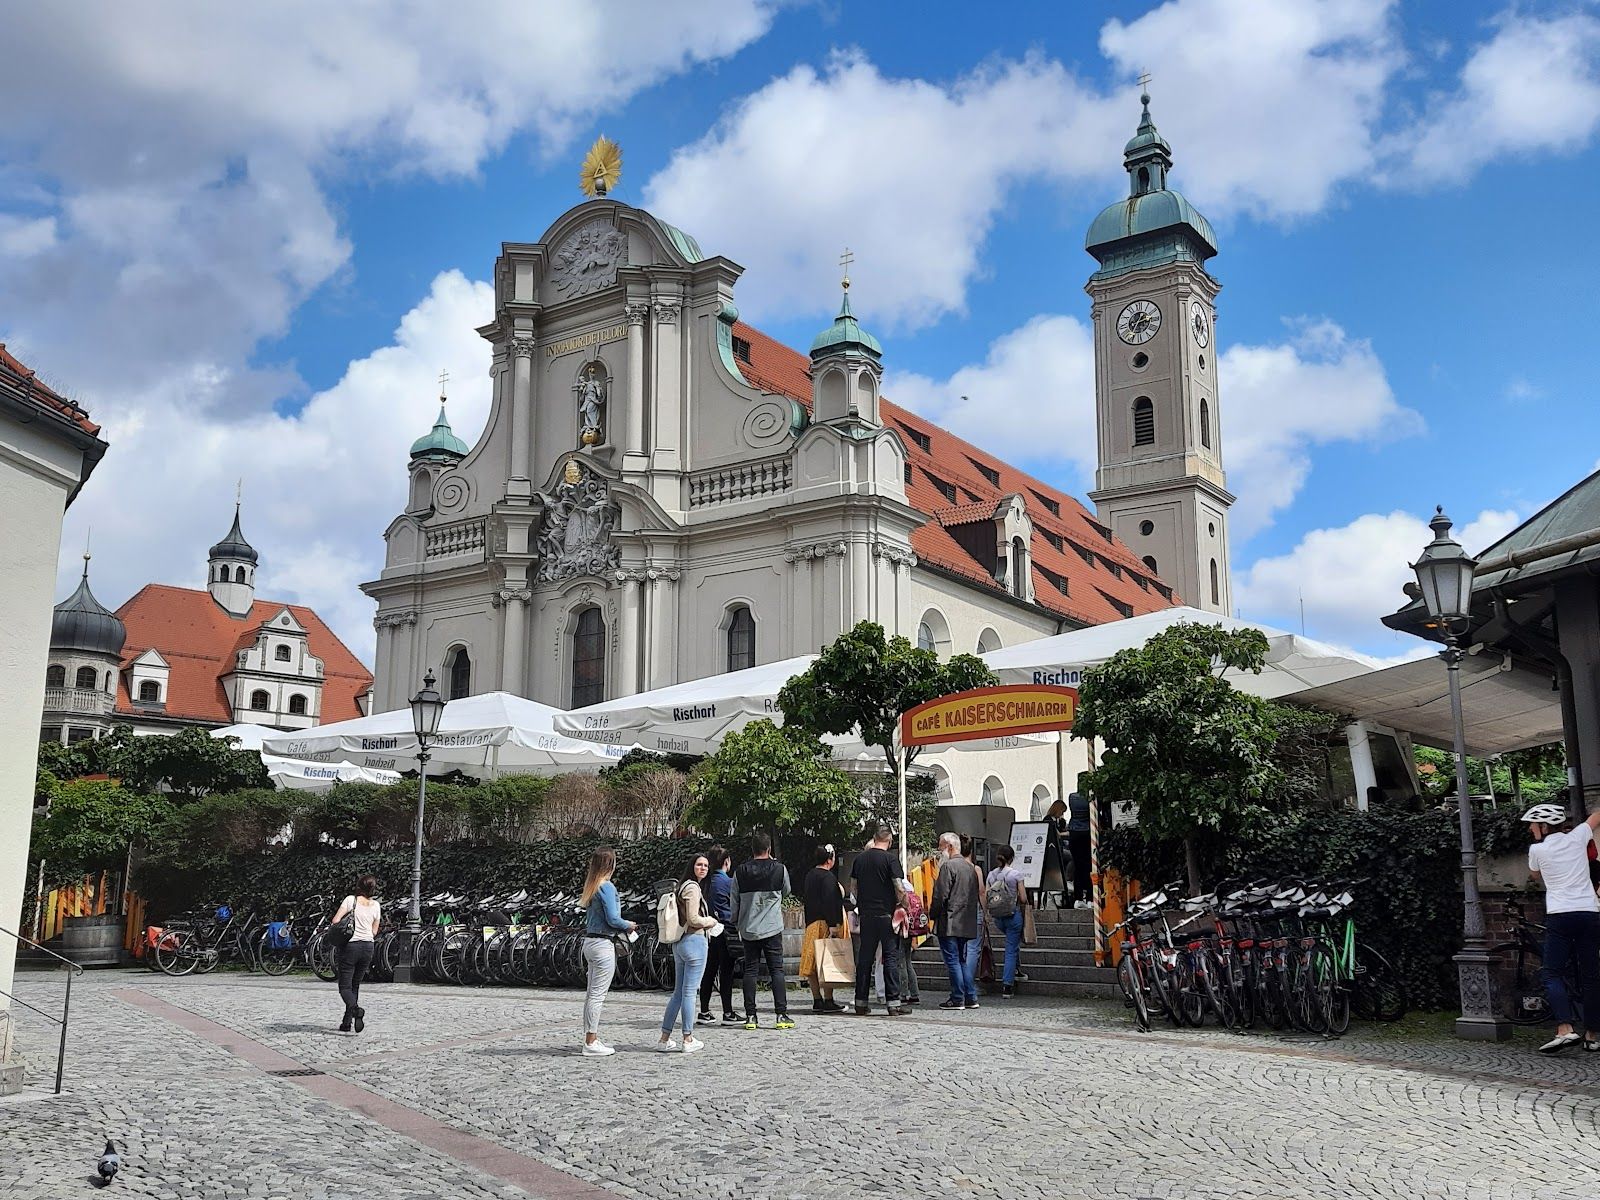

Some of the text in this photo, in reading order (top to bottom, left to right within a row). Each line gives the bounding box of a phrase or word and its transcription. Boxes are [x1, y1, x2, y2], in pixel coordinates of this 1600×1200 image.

[673, 704, 716, 721] Rischart
[916, 701, 1067, 731] CAFÉ KAISERSCHMARRN
[585, 715, 609, 729] Café
[362, 737, 398, 750] Rischart
[437, 732, 494, 746] Restaurant
[538, 735, 557, 750] Café
[287, 742, 307, 753] Café
[304, 766, 340, 778] Rischart
